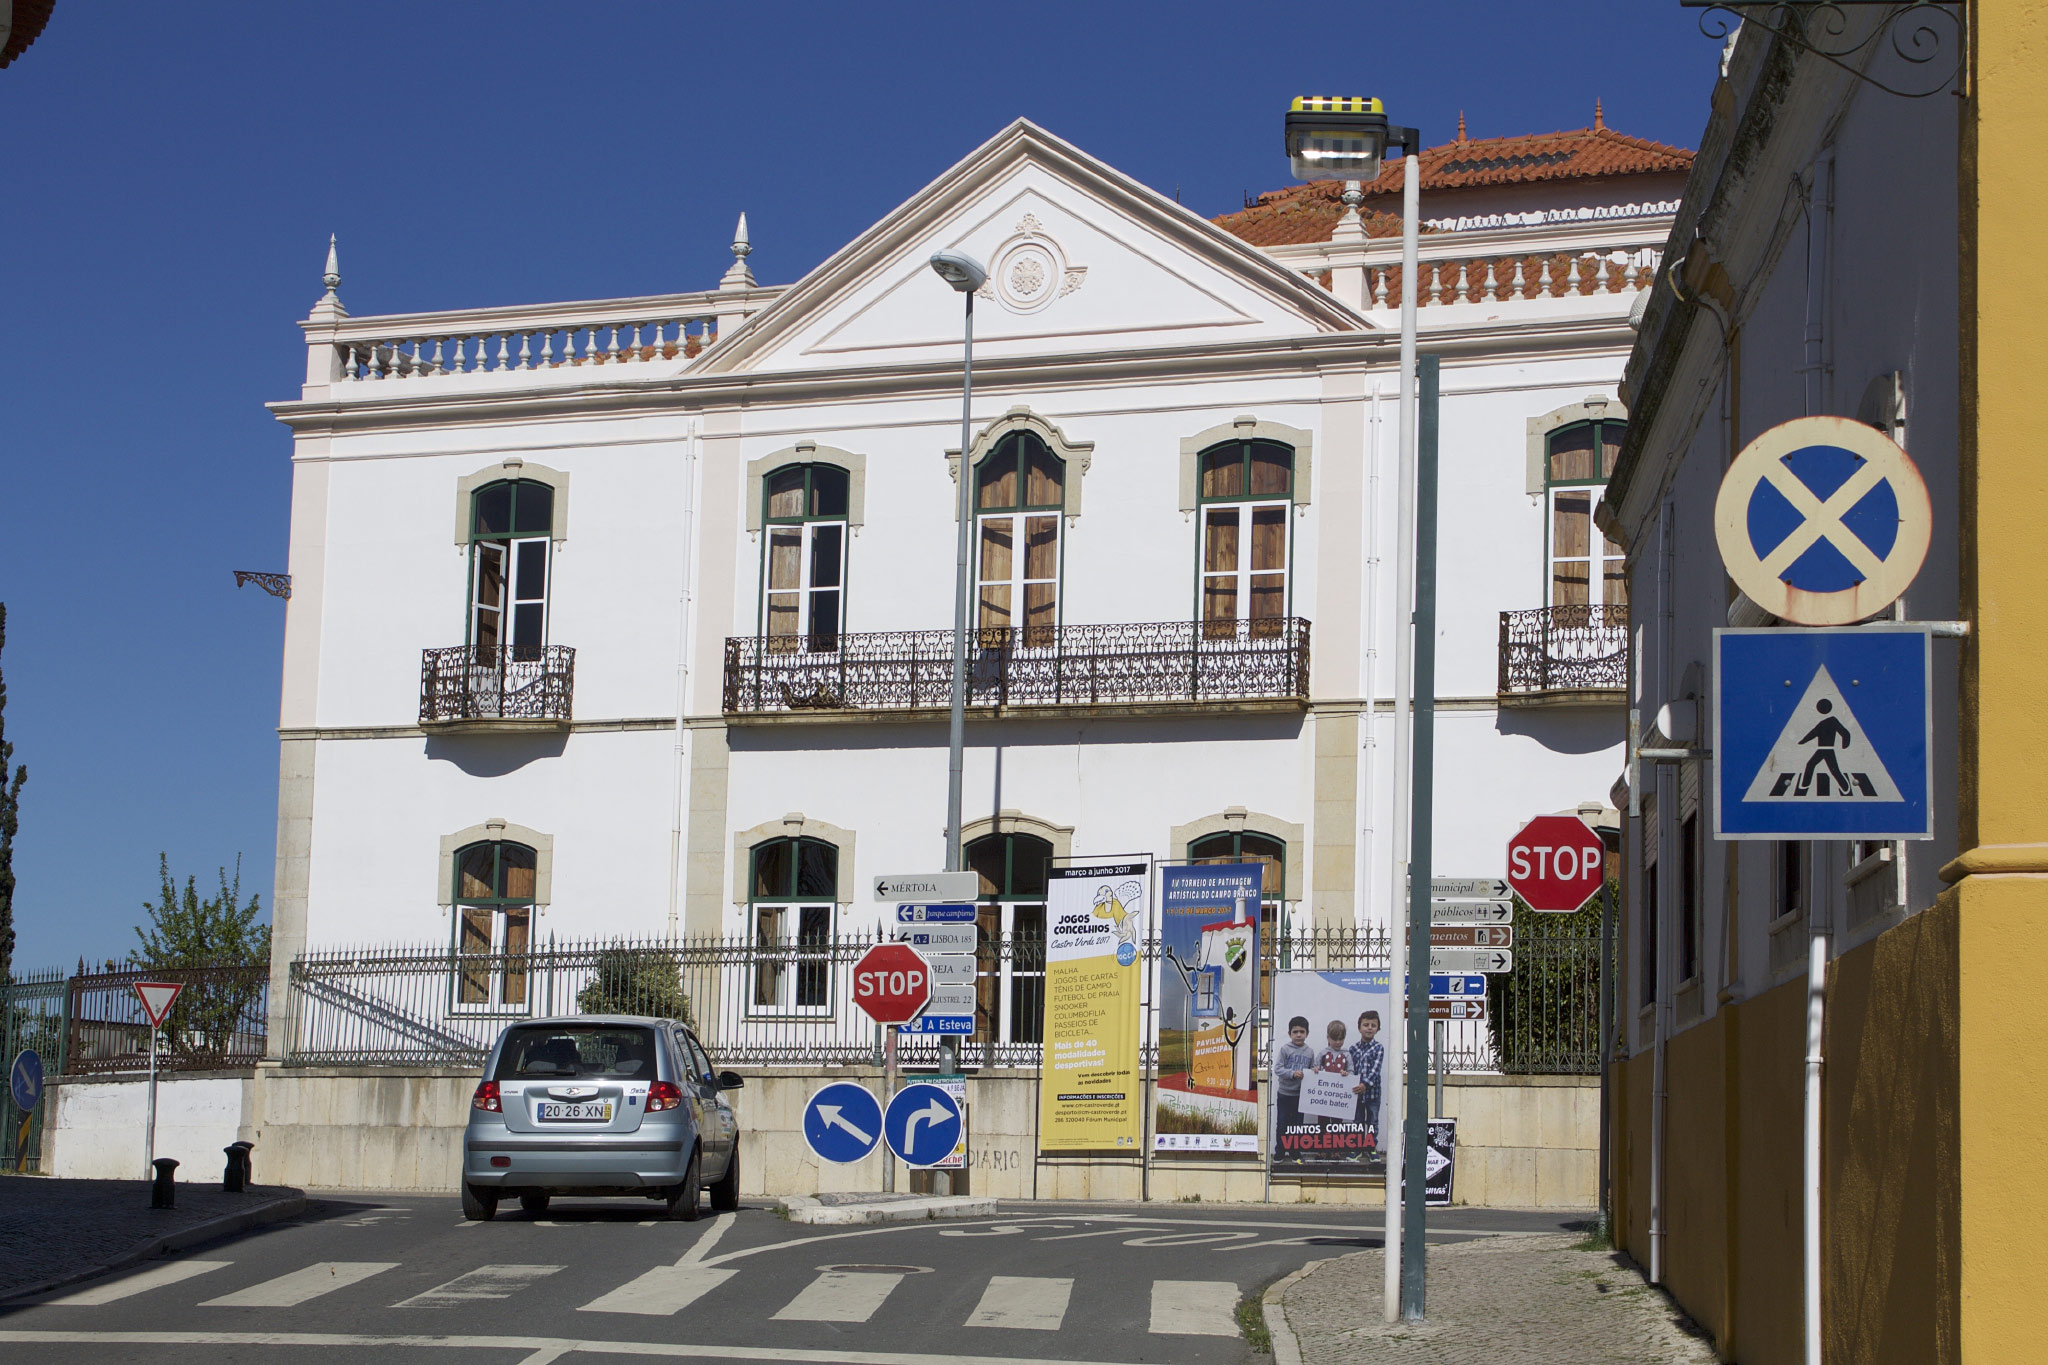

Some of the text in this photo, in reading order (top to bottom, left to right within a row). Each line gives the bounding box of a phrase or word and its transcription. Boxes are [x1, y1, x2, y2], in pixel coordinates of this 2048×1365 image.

[1511, 845, 1601, 881] STOP
[1094, 868, 1114, 876] junho
[1115, 866, 1130, 874] 2017
[1182, 878, 1206, 887] TORNEIO
[1208, 878, 1216, 886] DE
[1218, 877, 1252, 886] PATINAGEM
[891, 882, 937, 893] MÉRTOLA
[1169, 889, 1257, 900] ARTÍSTICA DO CAMPO BRANCO
[927, 908, 946, 919] parque
[1434, 906, 1474, 919] públicos
[1058, 915, 1090, 924] JOGOS
[931, 934, 959, 943] LISBOA
[932, 965, 954, 974] BEJA
[1054, 976, 1077, 984] JOGOS
[1091, 972, 1118, 981] CARTAS
[858, 970, 924, 997] STOP
[1075, 984, 1084, 992] DE
[1086, 982, 1112, 990] CAMPO
[1054, 994, 1085, 1002] FUTEBOL
[1054, 1002, 1088, 1011] SNOOKER
[928, 1020, 972, 1030] A Esteva
[1055, 1020, 1087, 1029] PASSEIOS
[1055, 1041, 1072, 1050] Mais
[1055, 1049, 1106, 1060] modalidades
[1055, 1059, 1104, 1070] desportivas!
[1324, 1090, 1352, 1100] coração
[1310, 1098, 1348, 1108] pode bater.
[1285, 1123, 1374, 1134] JUNTOS CONTRA A
[1281, 1133, 1376, 1150] VIOLÊNCIA
